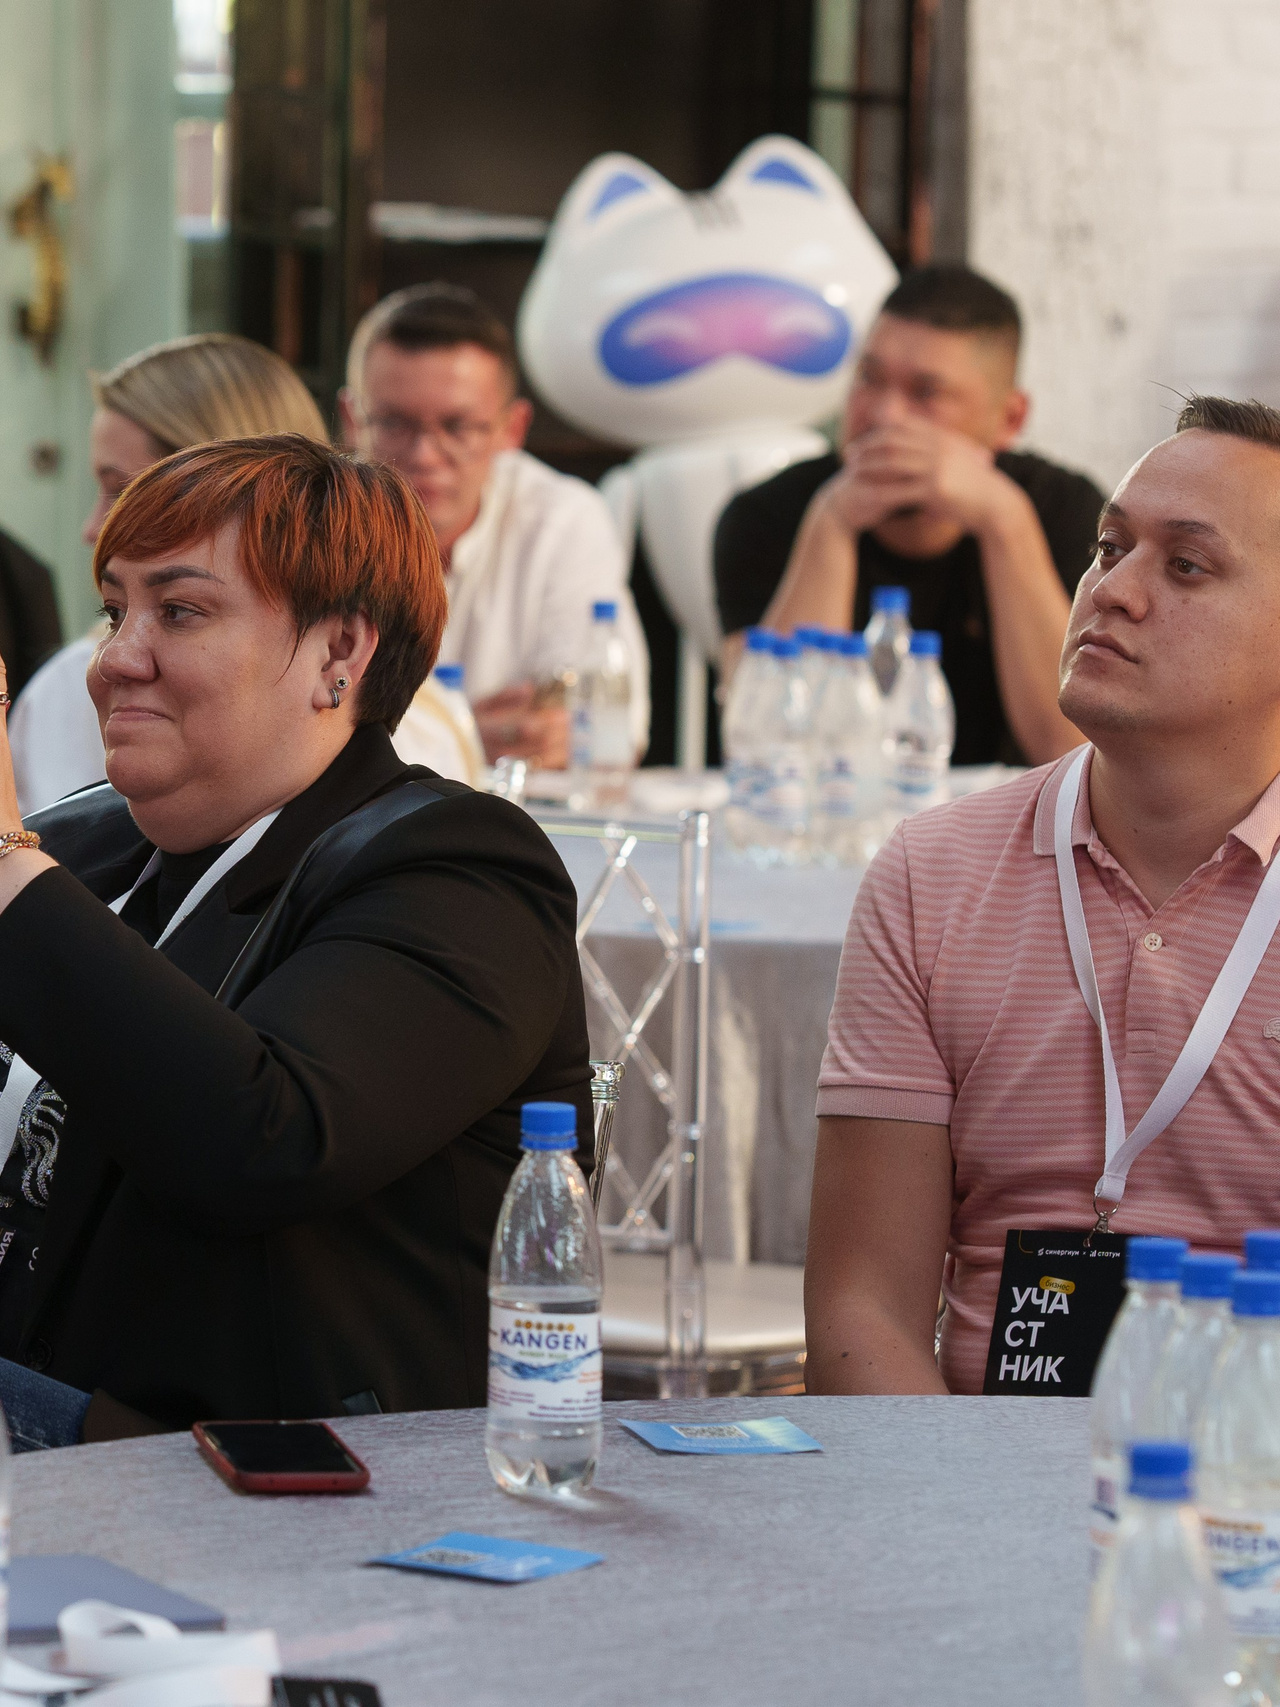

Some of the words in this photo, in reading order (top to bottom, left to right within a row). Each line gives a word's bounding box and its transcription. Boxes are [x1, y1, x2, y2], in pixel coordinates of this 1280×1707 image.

[1045, 1279, 1071, 1291] бизнес
[1010, 1286, 1070, 1315] УЧА
[500, 1328, 588, 1351] KANGEN
[1004, 1320, 1046, 1348] СТ
[998, 1353, 1065, 1383] НИК
